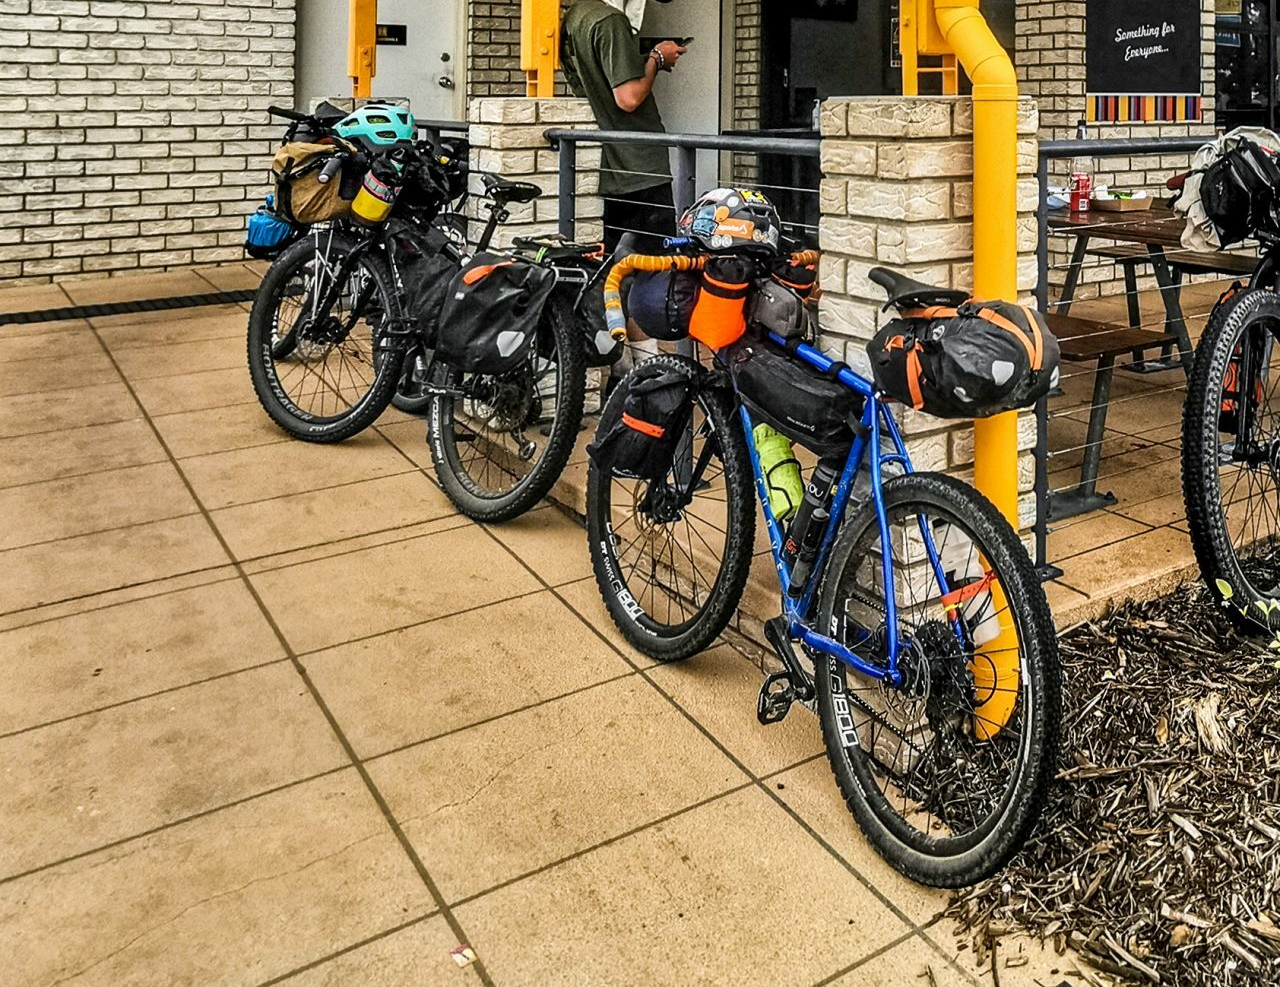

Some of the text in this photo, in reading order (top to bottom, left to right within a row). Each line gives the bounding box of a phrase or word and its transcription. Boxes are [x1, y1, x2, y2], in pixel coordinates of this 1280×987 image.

[1114, 21, 1175, 42] Something for
[431, 395, 441, 439] MEZCA
[831, 675, 860, 748] G1800
